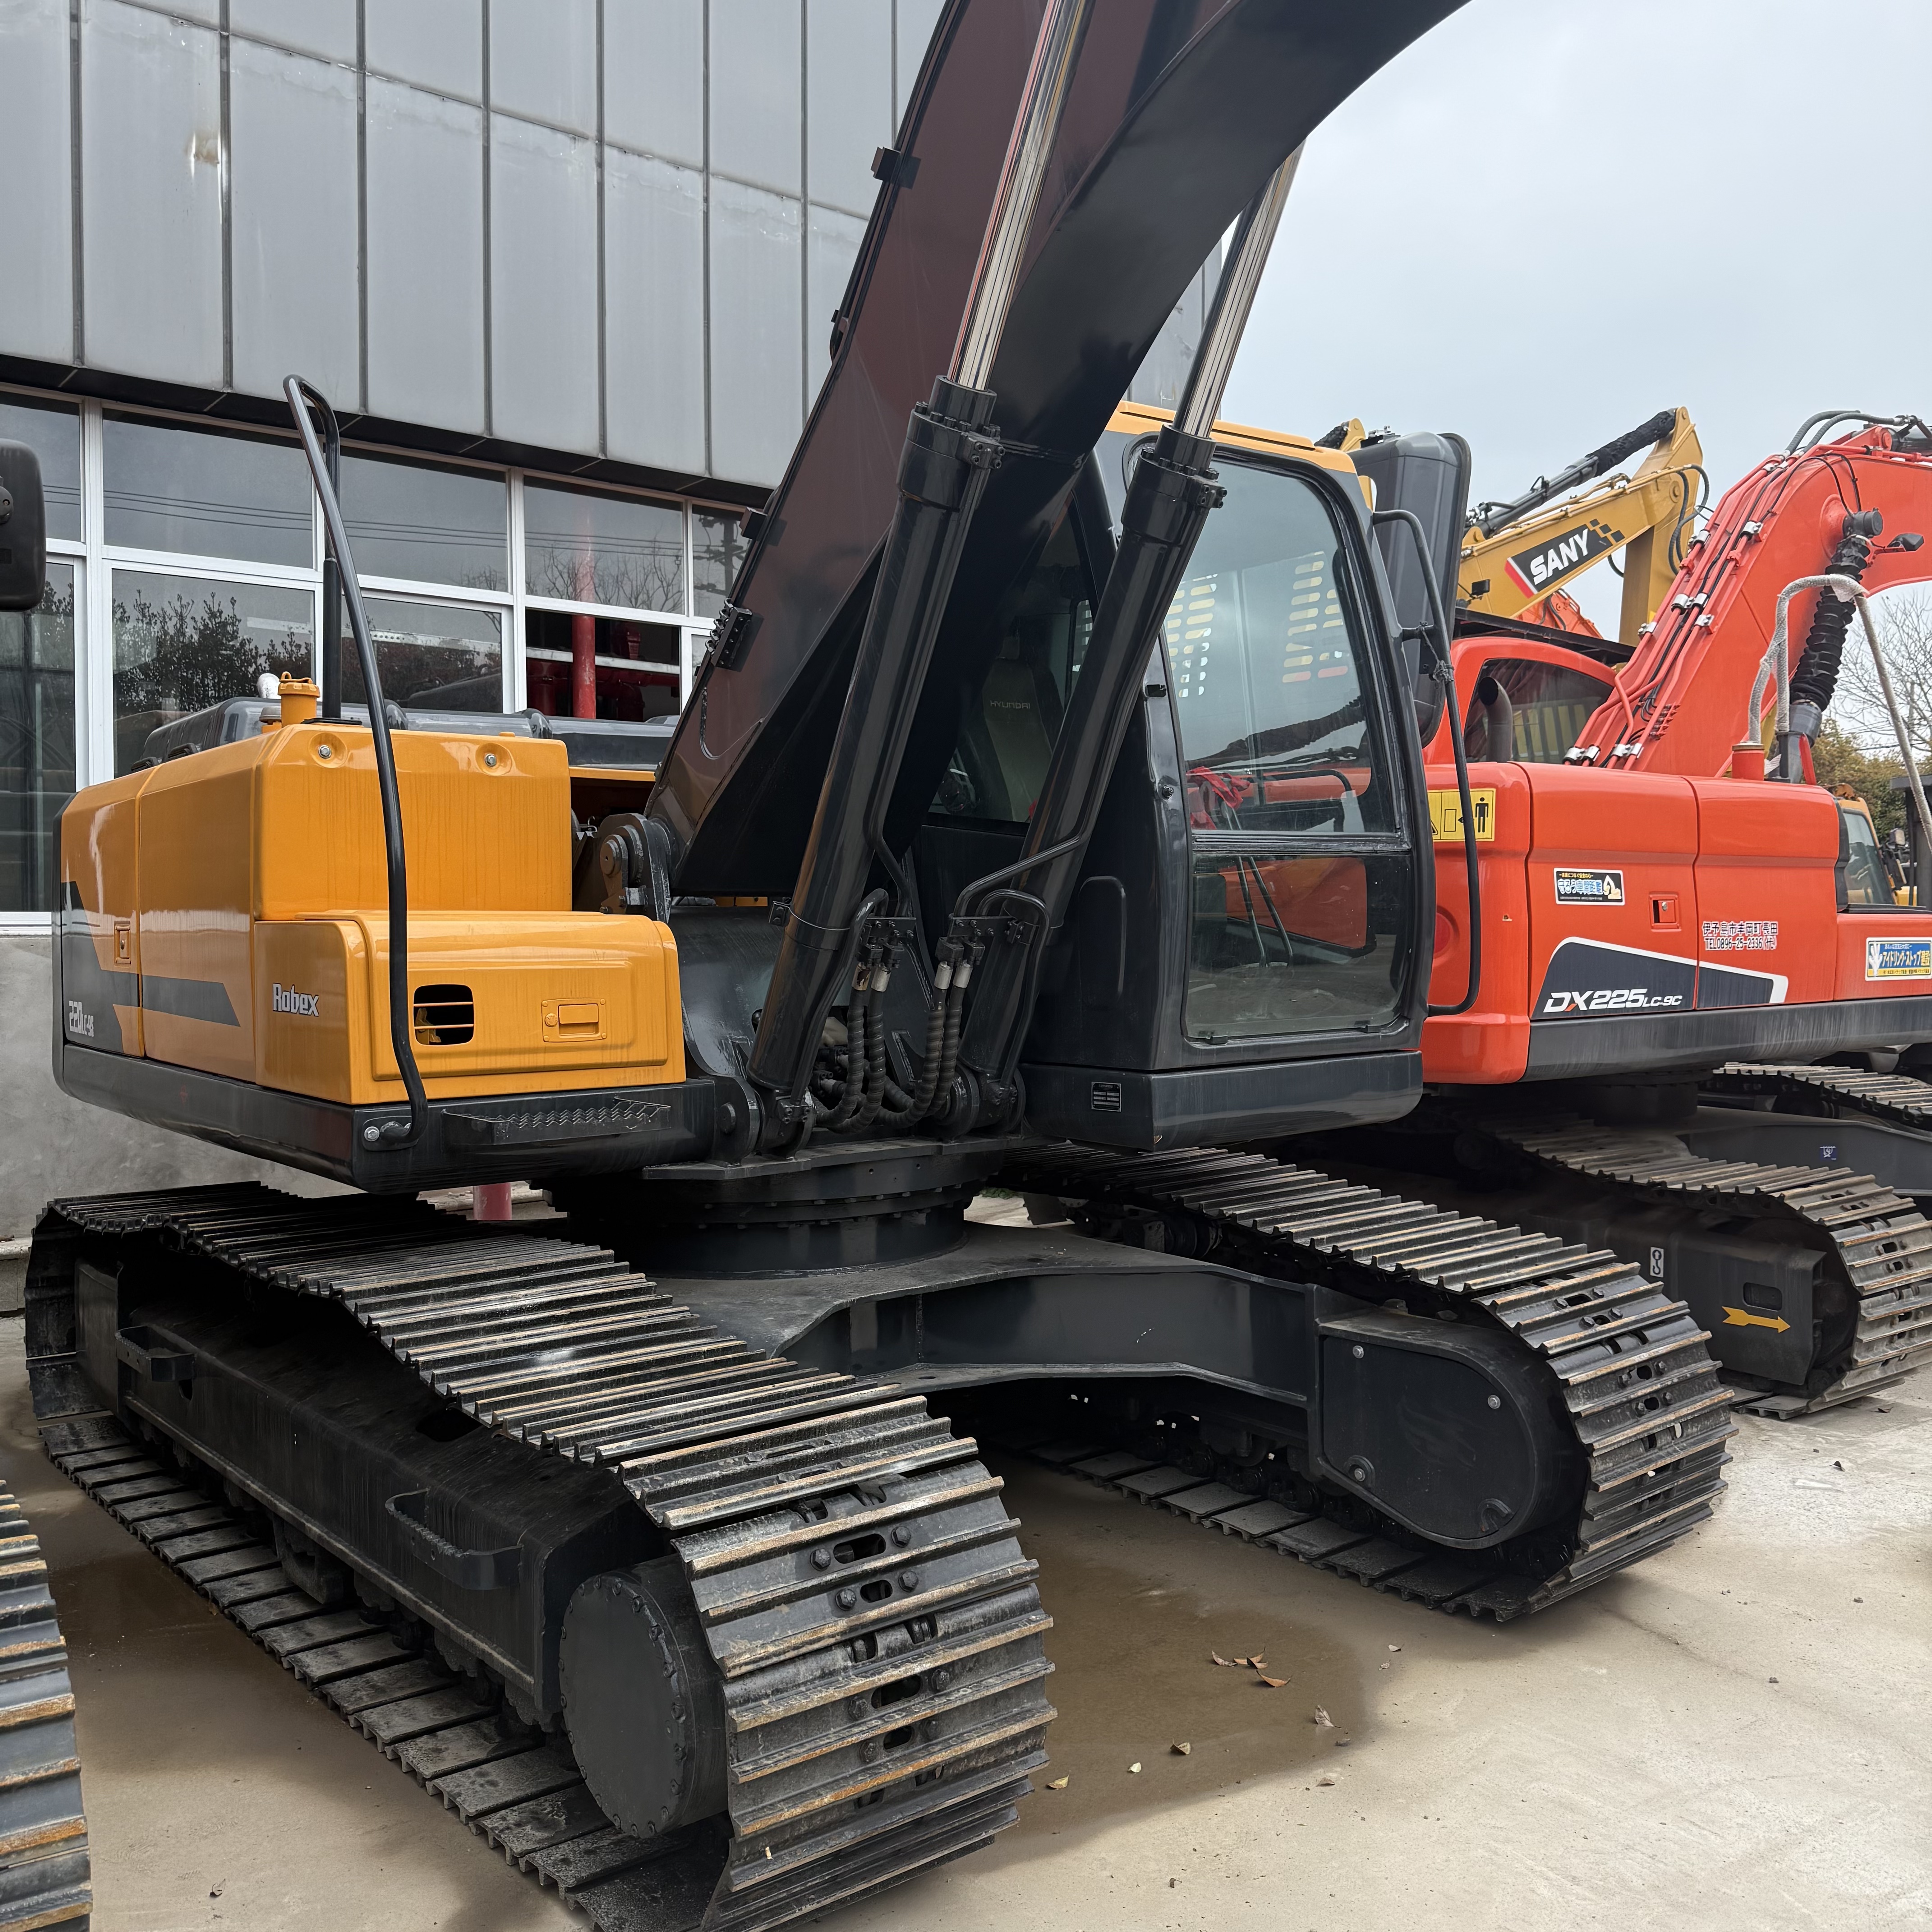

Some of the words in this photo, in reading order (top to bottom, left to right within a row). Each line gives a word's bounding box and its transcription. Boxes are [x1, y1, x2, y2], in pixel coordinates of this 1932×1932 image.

[1530, 528, 1588, 585] SANY
[990, 700, 1030, 709] HYUNDAI
[273, 983, 319, 1017] Robex
